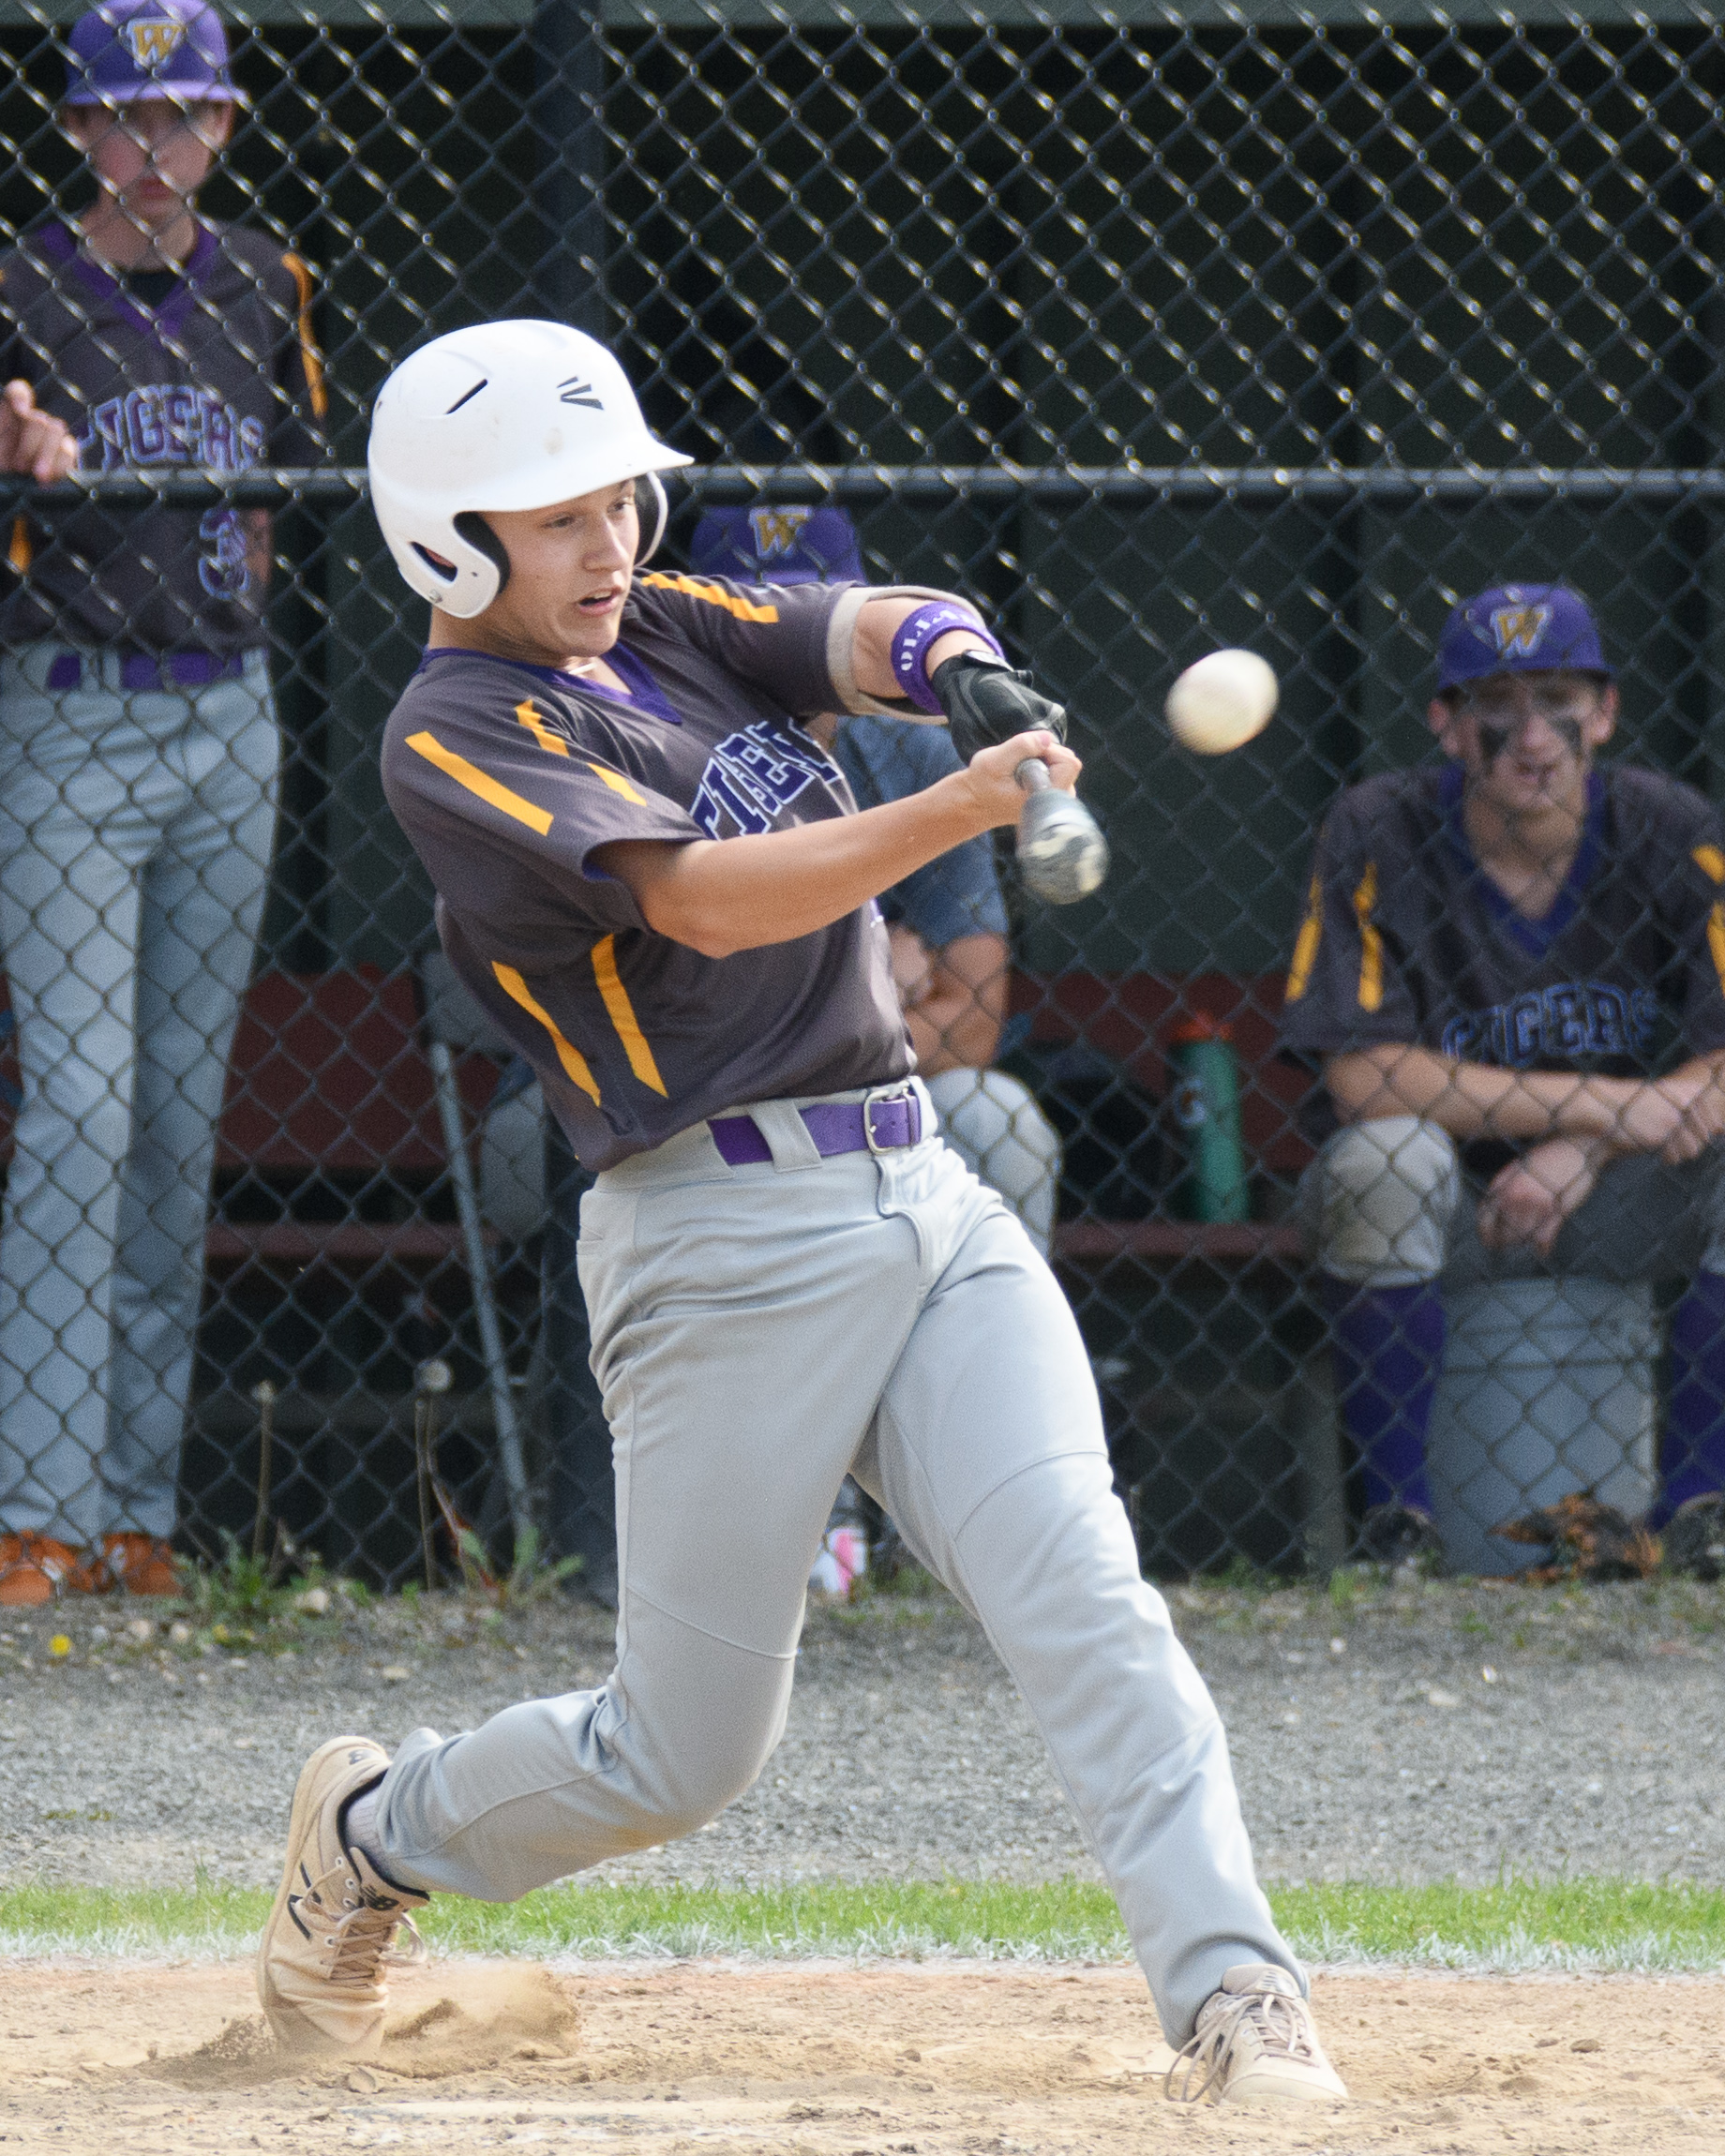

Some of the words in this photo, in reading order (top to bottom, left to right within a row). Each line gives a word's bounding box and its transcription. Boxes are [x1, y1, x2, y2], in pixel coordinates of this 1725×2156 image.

[126, 16, 185, 71] W
[748, 503, 814, 561] W
[1490, 604, 1553, 658] W
